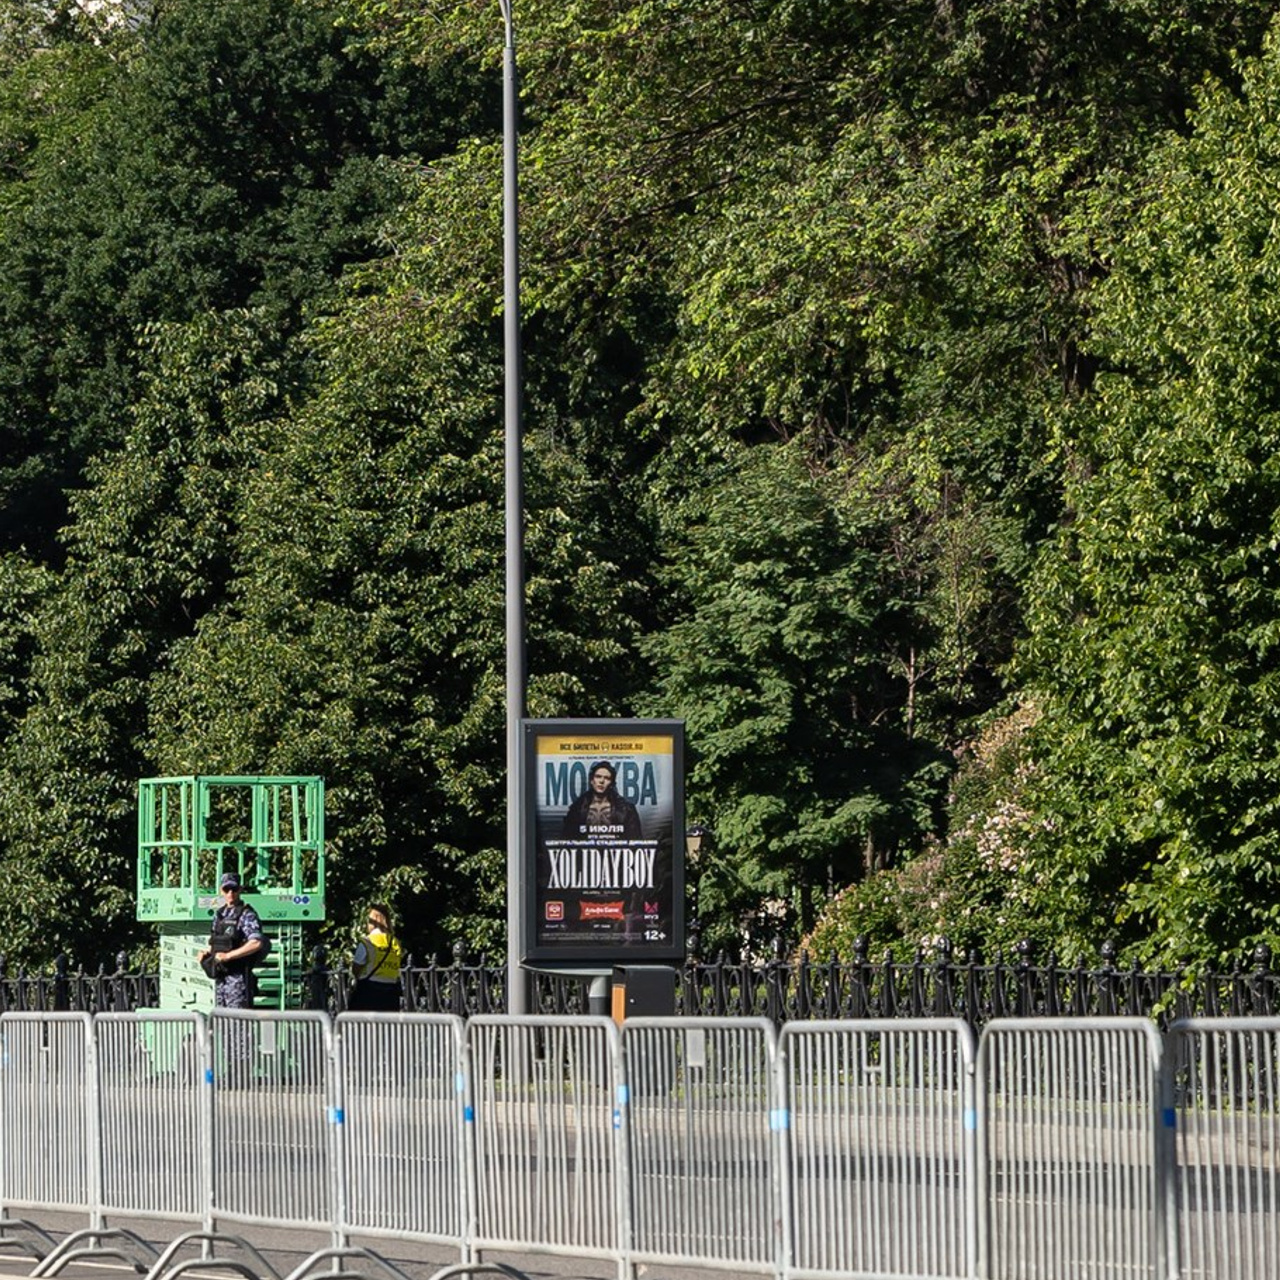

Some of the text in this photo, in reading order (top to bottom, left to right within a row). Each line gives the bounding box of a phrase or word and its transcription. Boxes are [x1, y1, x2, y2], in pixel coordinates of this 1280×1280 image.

[579, 825, 625, 833] 5 ИЮЛЯ
[547, 848, 657, 889] XOLIDAYBOY
[644, 930, 666, 940] 12+
